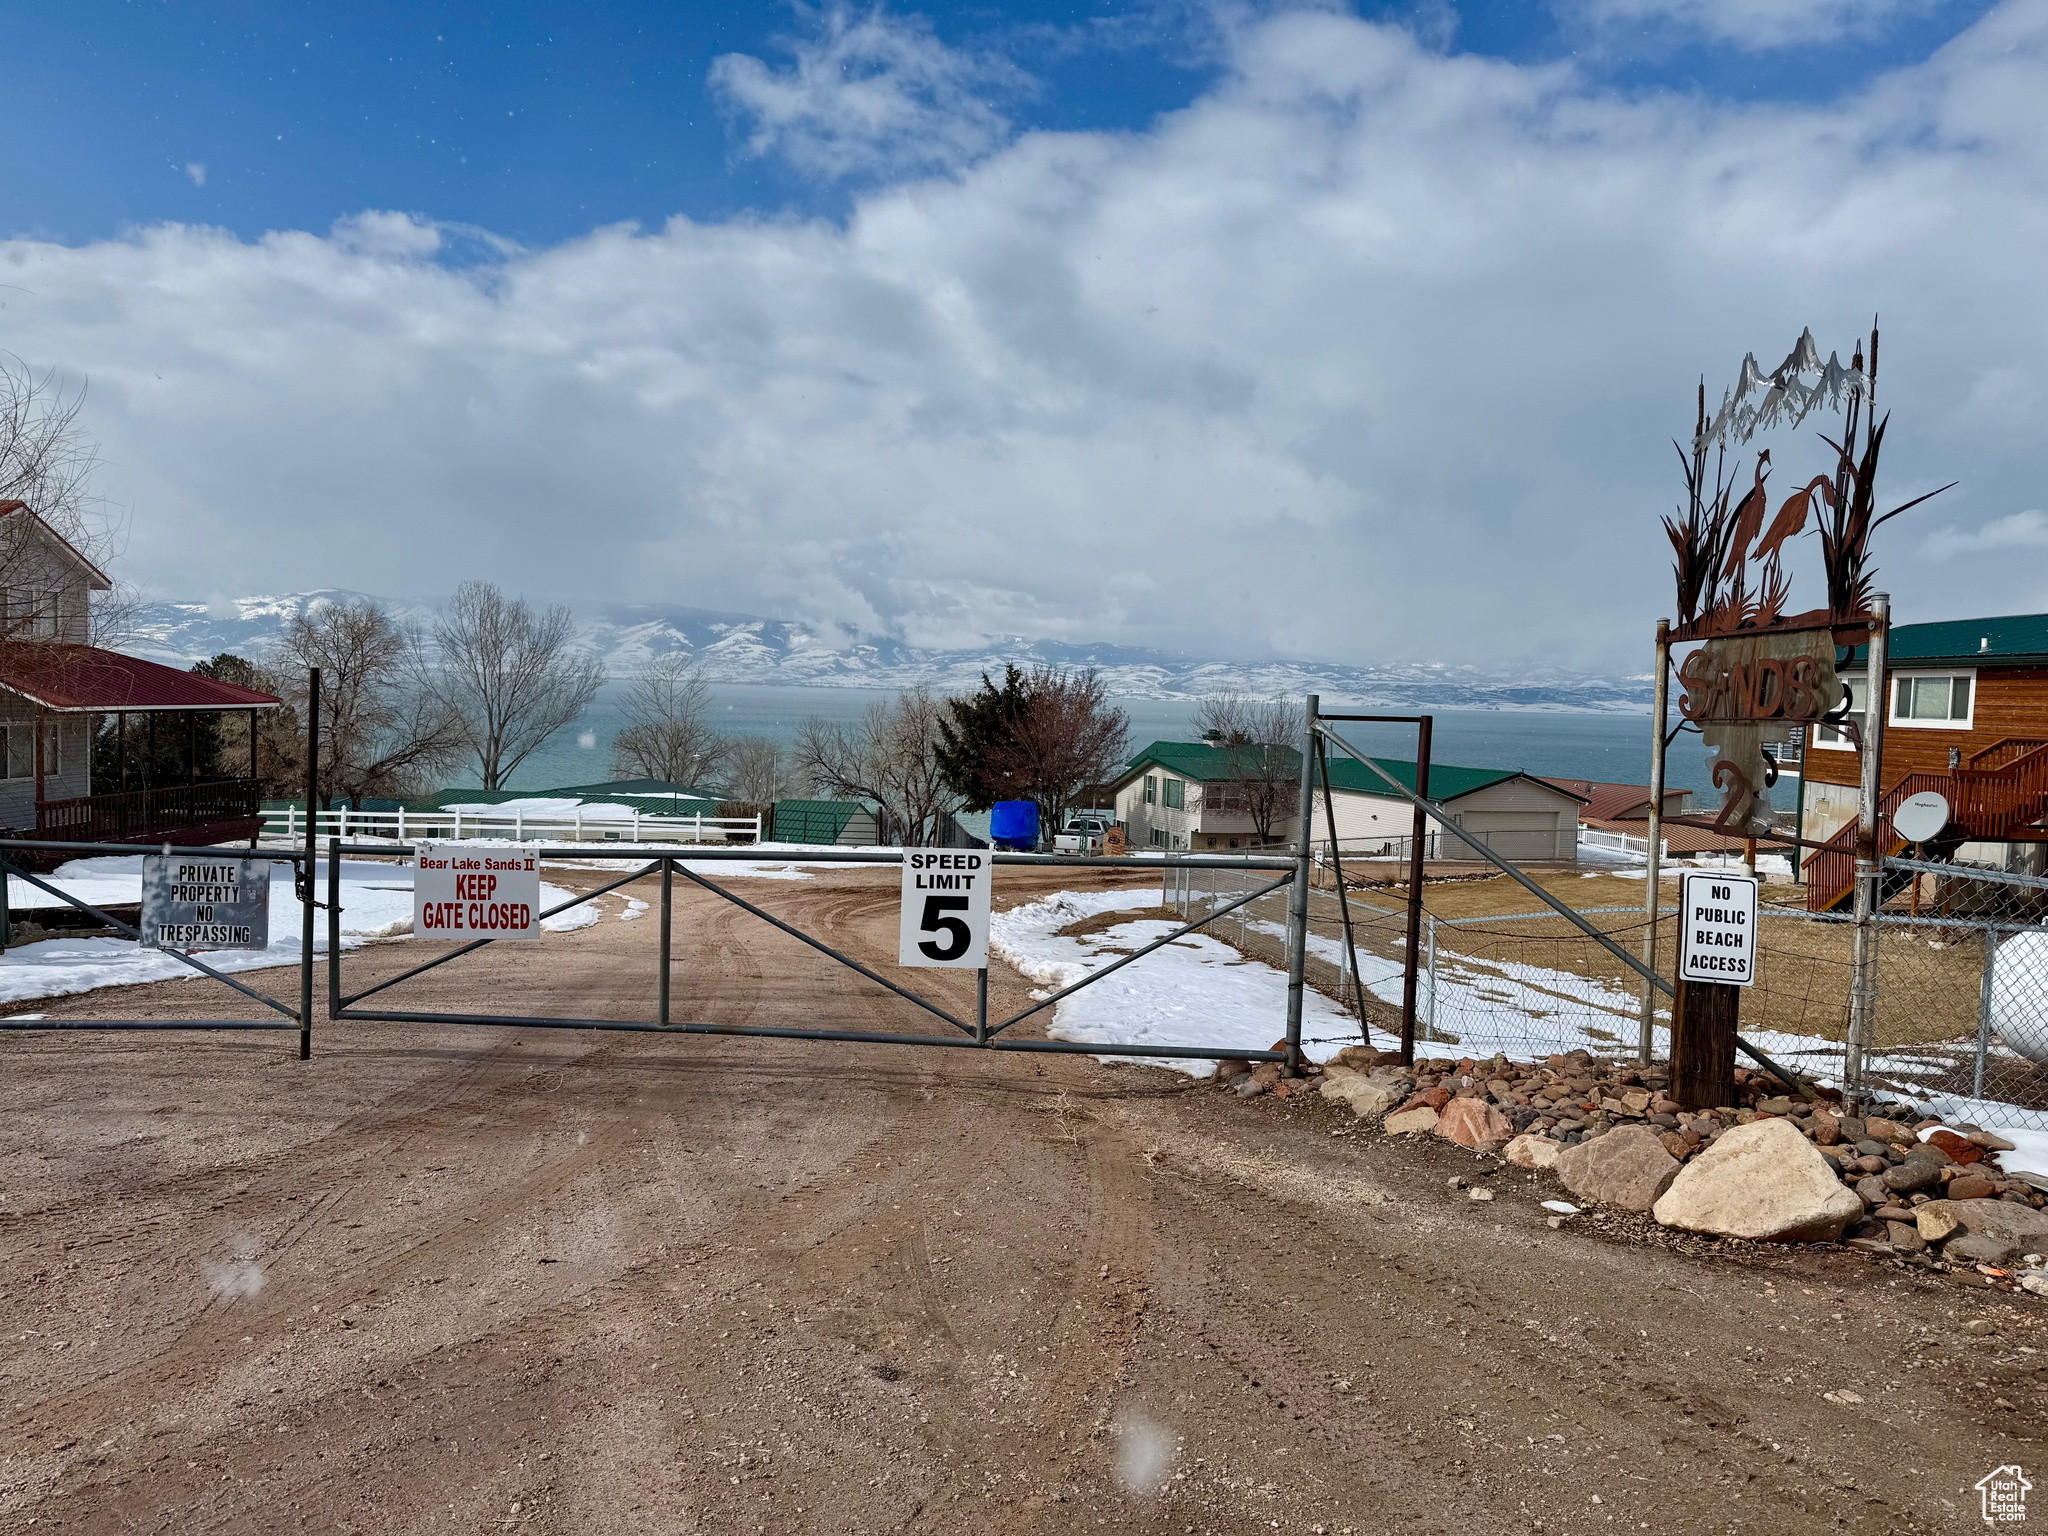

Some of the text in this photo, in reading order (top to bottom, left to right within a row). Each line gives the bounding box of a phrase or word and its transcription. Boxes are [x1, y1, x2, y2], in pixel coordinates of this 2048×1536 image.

[1678, 649, 1817, 720] SANDS
[1712, 760, 1748, 838] 2
[420, 857, 535, 871] Bear Lake Sands II
[910, 854, 982, 870] SPEED
[179, 865, 235, 883] PRIVATE
[916, 874, 976, 890] LIMIT
[171, 885, 240, 902] PROPERTY
[456, 874, 497, 901] KEEP
[1711, 885, 1731, 901] NO
[196, 905, 213, 922] NO
[423, 902, 530, 930] GATE CLOSED
[1695, 907, 1746, 925] PUBLIC
[159, 925, 250, 943] TRESPASSING
[917, 895, 972, 962] 5
[1696, 930, 1743, 948] BEACH
[1689, 954, 1747, 973] ACCESS
